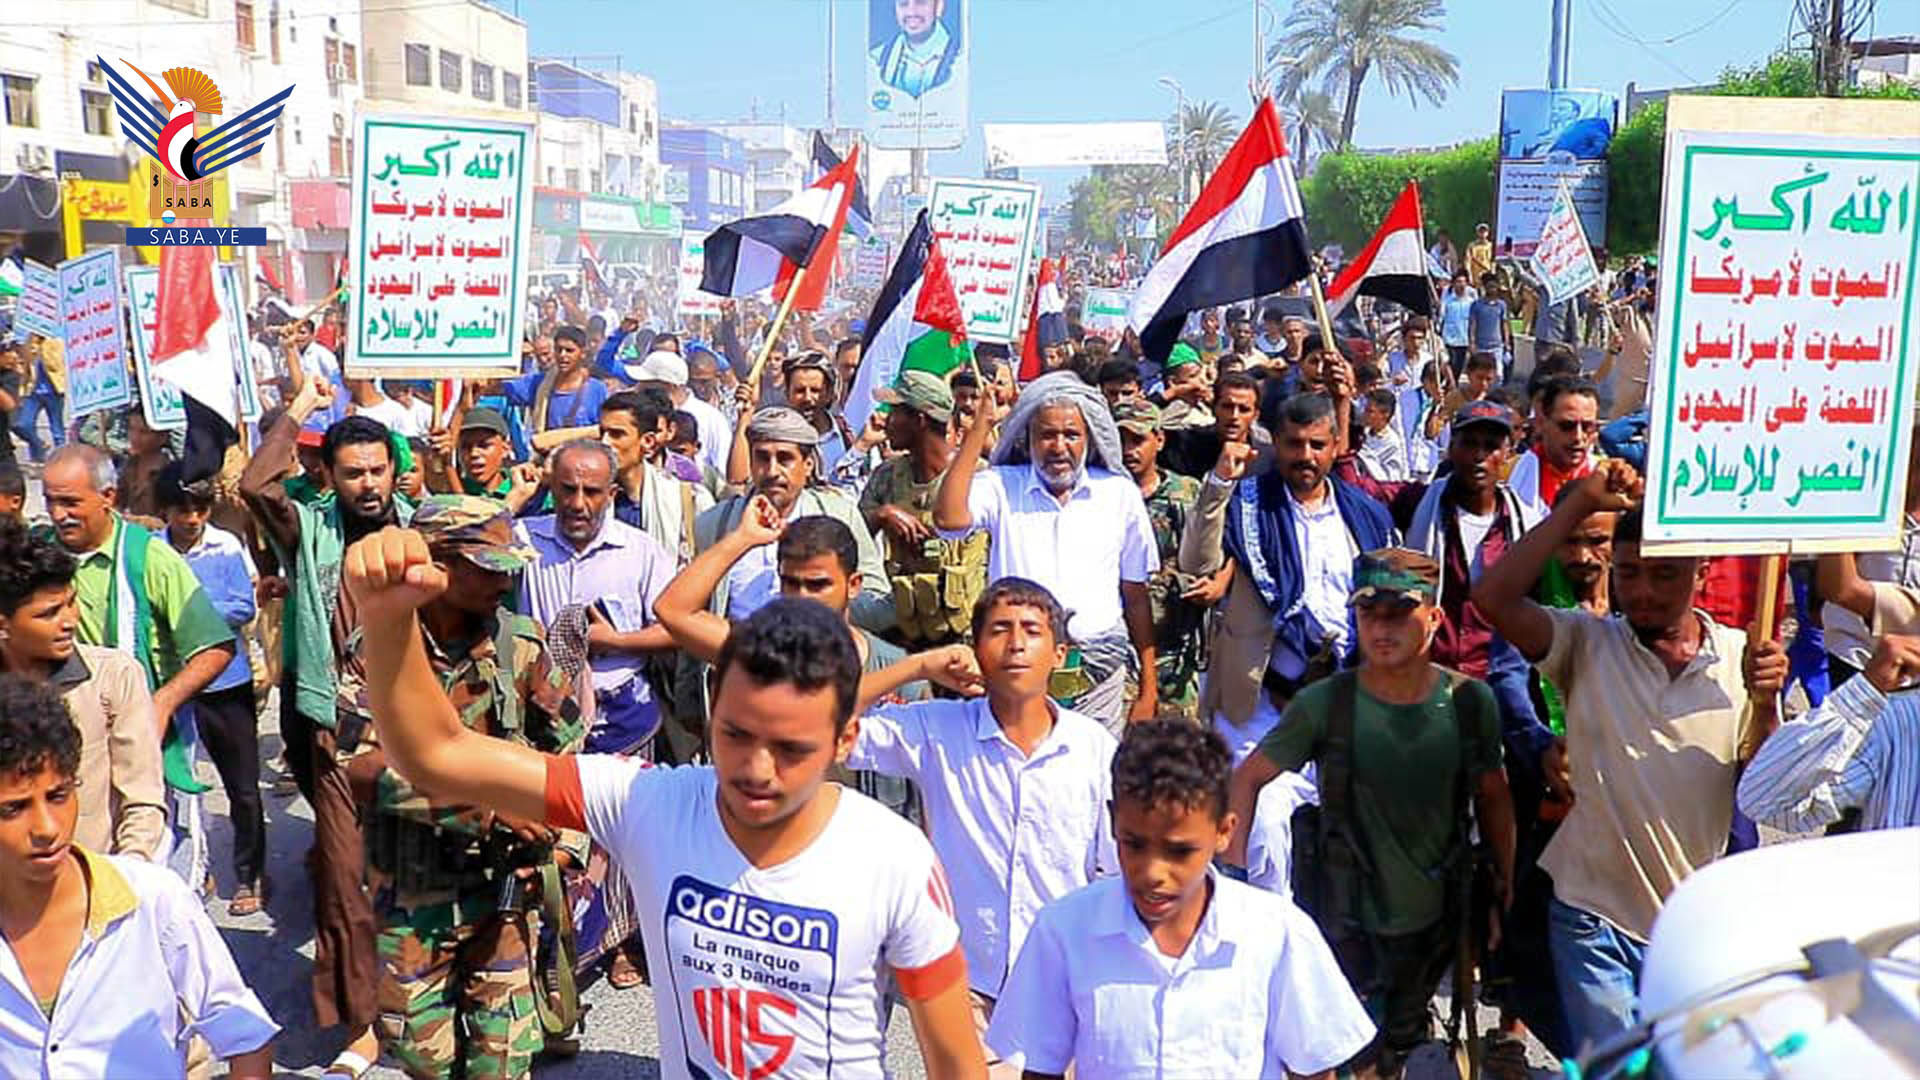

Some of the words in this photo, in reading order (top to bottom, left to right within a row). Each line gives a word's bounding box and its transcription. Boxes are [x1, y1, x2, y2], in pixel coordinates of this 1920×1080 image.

[372, 134, 460, 187] أكبر
[464, 143, 514, 179] الله
[372, 187, 447, 221] لأمريكا
[453, 196, 511, 223] الموت
[992, 196, 1026, 220] الله
[1693, 163, 1829, 249] أكبر
[1829, 175, 1909, 235] الله
[370, 231, 445, 263] لإسرائيل
[452, 236, 509, 263] الموت
[368, 272, 422, 300] اليهود
[428, 274, 455, 300] على
[464, 272, 507, 296] اللعنة
[1691, 249, 1803, 304] لأمريكا
[1811, 262, 1900, 306] الموت
[367, 306, 438, 350] للإسلام
[444, 305, 505, 347] النصر
[1684, 321, 1797, 372] لإسرائيل
[1805, 325, 1894, 370] الموت
[1679, 385, 1757, 432] اليهود
[1765, 387, 1807, 432] على
[1820, 385, 1887, 424] اللعنة
[1673, 444, 1780, 509] للإسلام
[1784, 439, 1881, 507] النصر
[676, 887, 830, 950] adison
[682, 953, 715, 975] aux
[722, 962, 734, 978] 3
[740, 965, 812, 994] bandes
[693, 932, 718, 954] La
[724, 942, 800, 973] marque
